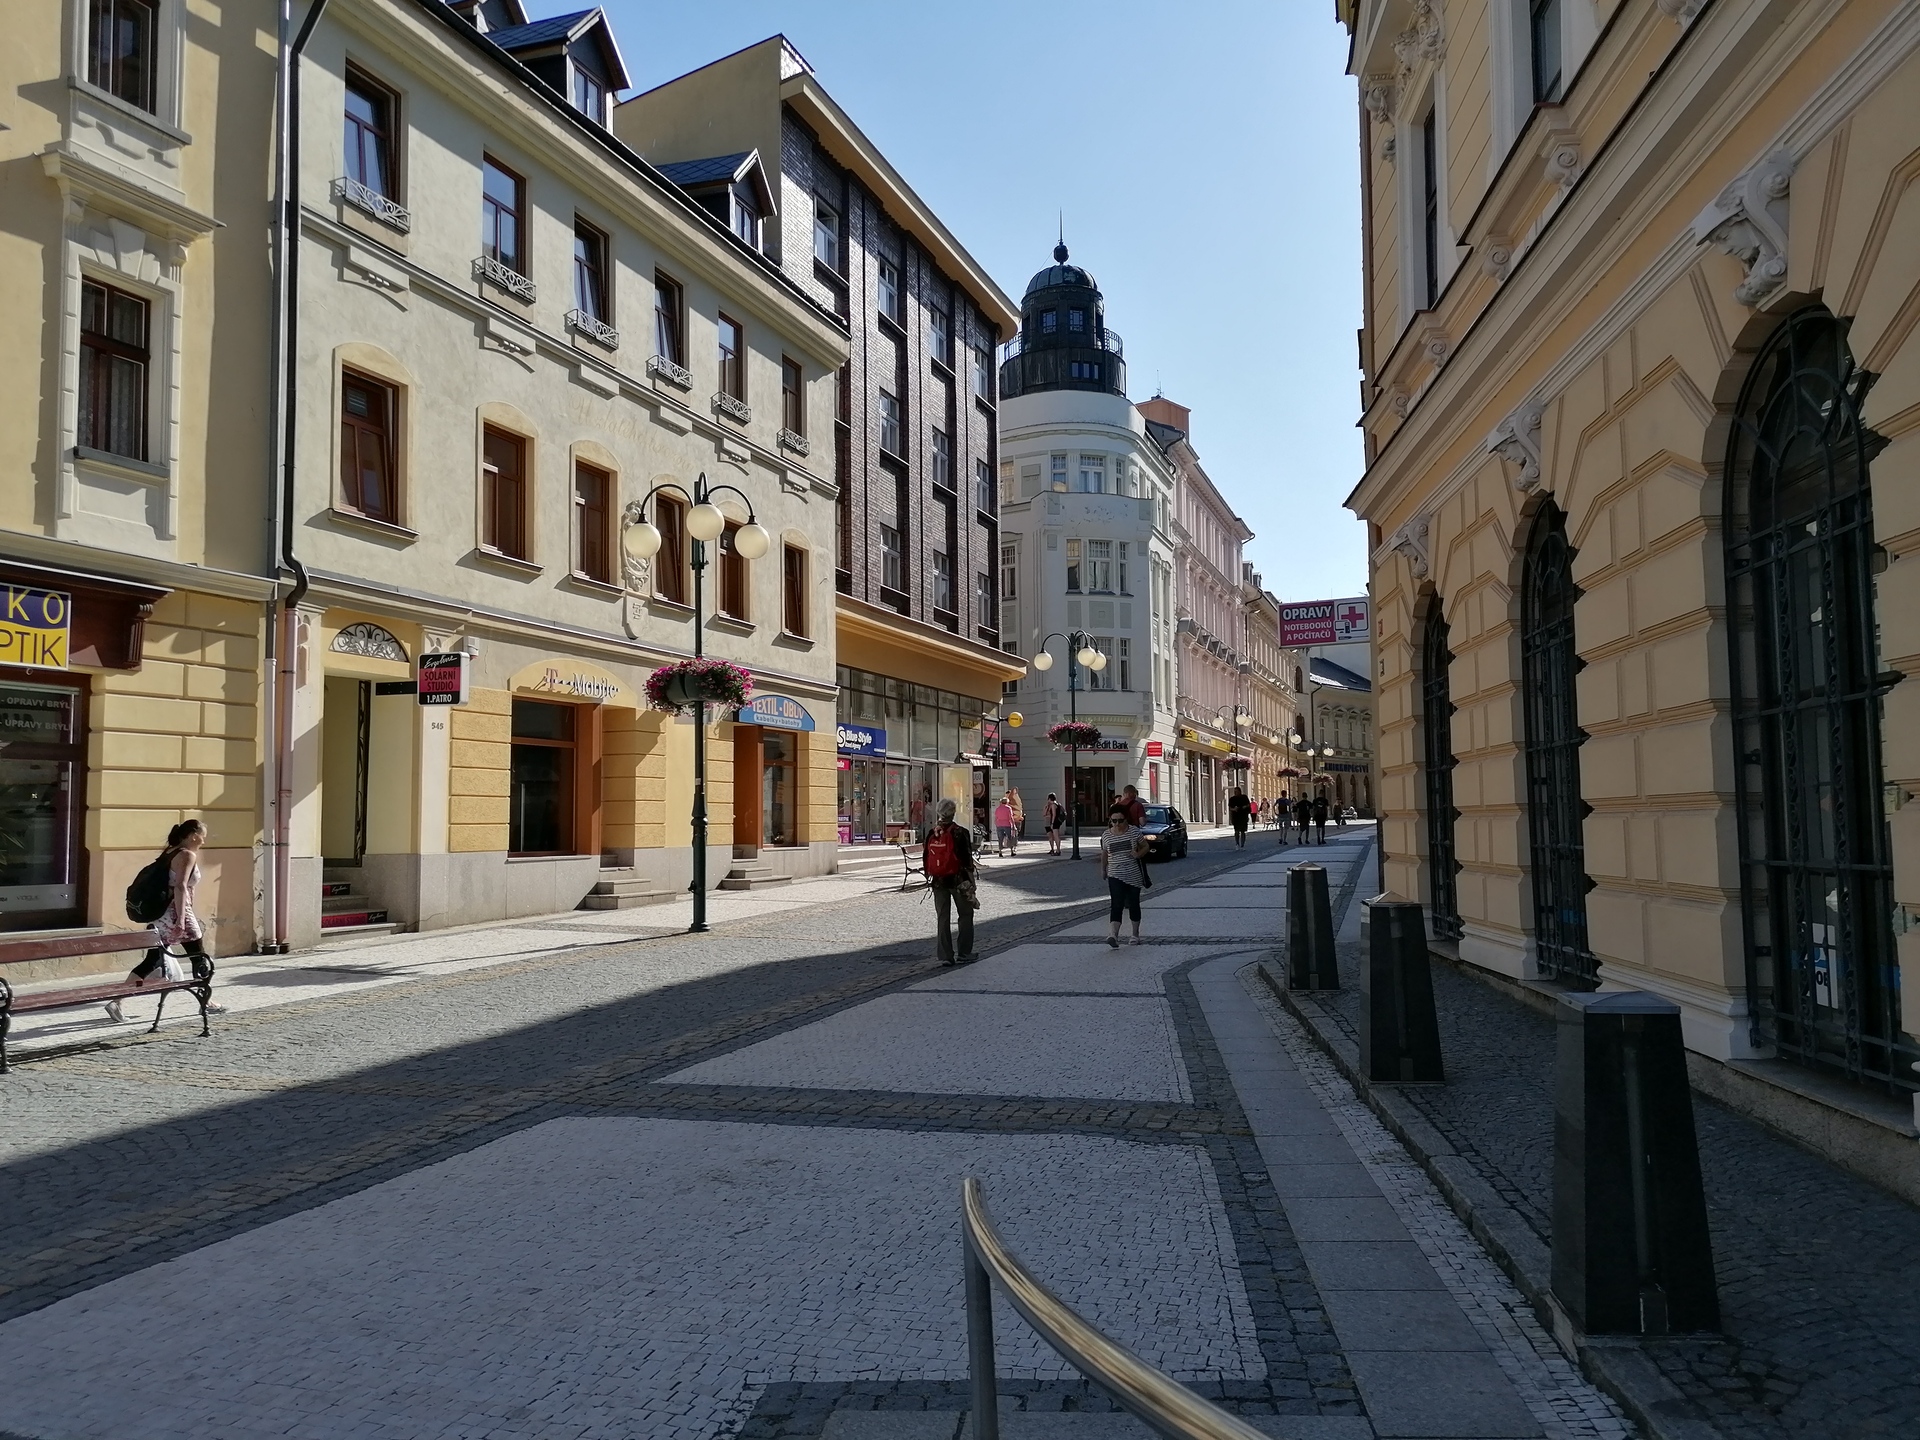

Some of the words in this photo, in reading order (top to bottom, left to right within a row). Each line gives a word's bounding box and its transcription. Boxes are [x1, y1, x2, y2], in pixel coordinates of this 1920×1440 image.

[1283, 605, 1332, 620] OPRAVY
[1284, 620, 1332, 631] NOTEBOOKŮ
[1286, 633, 1293, 641] A
[1293, 629, 1331, 640] POČÍTAČŮ
[424, 668, 456, 681] SOLÁRNÍ
[427, 681, 454, 691] STUDIO
[7, 697, 44, 707] OPRAVY
[427, 694, 452, 703] 1.PATRO
[752, 697, 779, 716] TEXTIL
[783, 700, 804, 720] OBUV
[431, 722, 444, 730] 545
[756, 715, 778, 724] kabelky
[781, 718, 800, 728] batohy
[846, 730, 858, 742] Blue
[858, 731, 872, 746] Style
[1113, 740, 1129, 750] Bank
